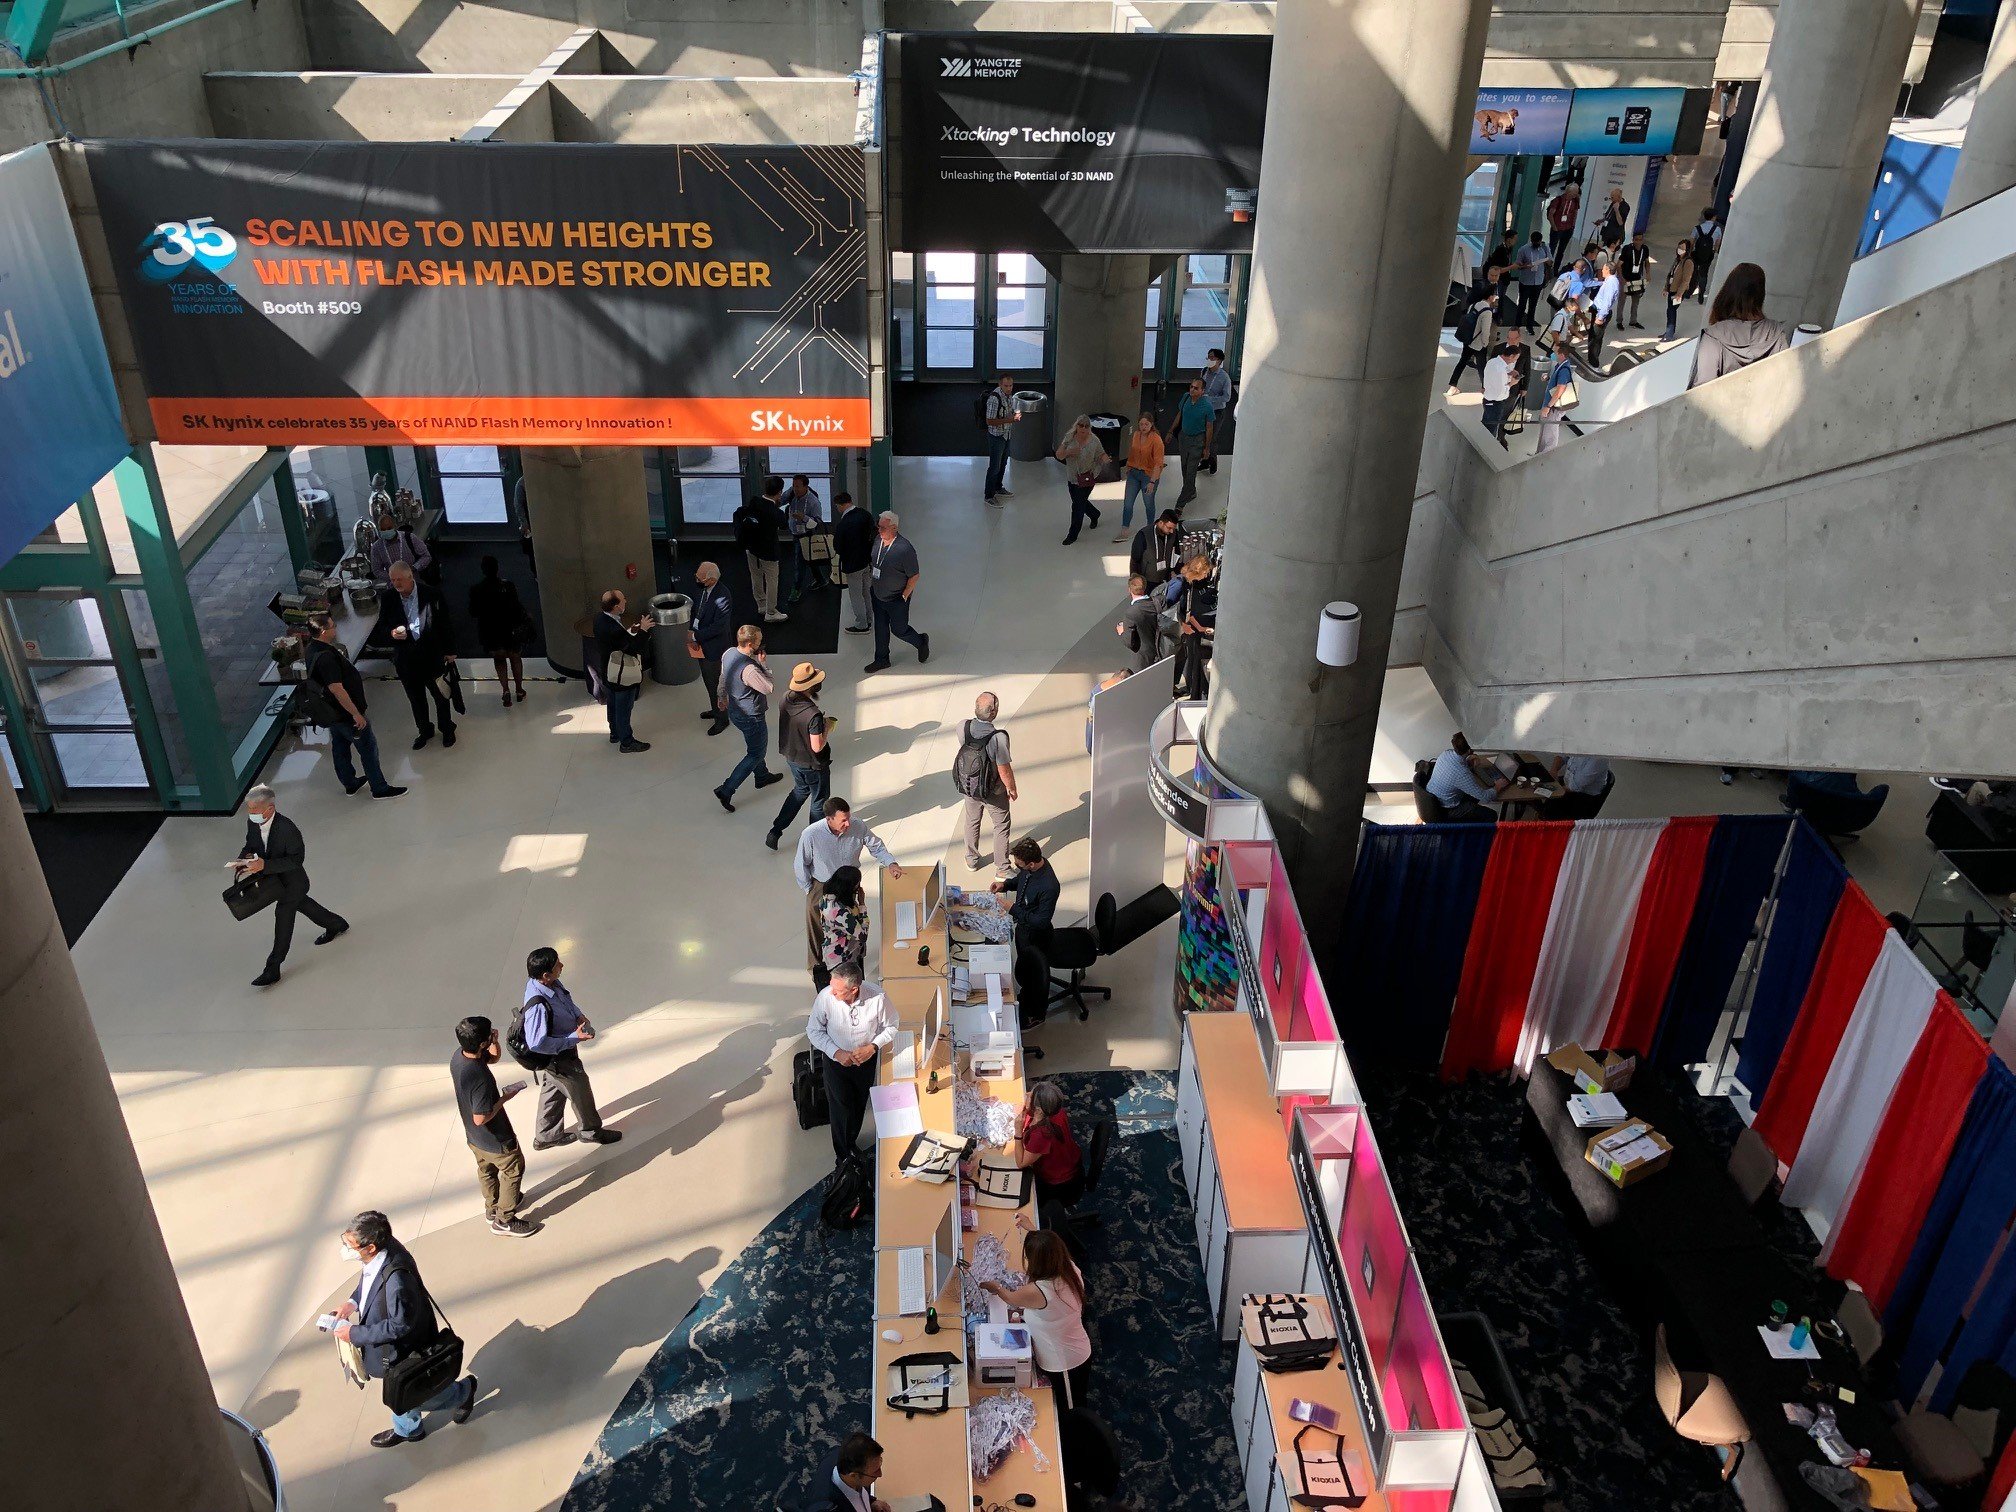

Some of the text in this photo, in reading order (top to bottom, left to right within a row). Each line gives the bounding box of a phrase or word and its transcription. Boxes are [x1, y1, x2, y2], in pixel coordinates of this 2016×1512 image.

[974, 58, 1022, 68] YANGTZE
[974, 69, 1019, 78] MEMORY
[1501, 94, 1520, 104] you
[1526, 94, 1536, 103] to
[1021, 126, 1116, 146] Technology
[940, 170, 1114, 182] Unleashing the Potential of 3D NAND
[246, 218, 714, 249] SCALING TO NEW HEIGHTS
[152, 216, 237, 266] 35
[252, 259, 772, 288] WITH FLASH MADE STRONGER
[168, 284, 237, 296] YEARS OF
[173, 304, 244, 314] INNOVATION
[262, 301, 362, 315] Booth #509
[182, 414, 210, 429] SK
[212, 414, 266, 432] hynix
[267, 417, 347, 429] celebrates
[349, 417, 368, 429] 35
[370, 418, 411, 431] years
[413, 417, 428, 429] of
[431, 417, 478, 429] NAND
[481, 417, 520, 429] Flash
[522, 417, 583, 431] Memory
[586, 416, 665, 429] Innovation
[750, 410, 845, 437] SK hynix
[1002, 1173, 1010, 1192] KIOXIA
[1310, 1476, 1341, 1484] KIOXIA
